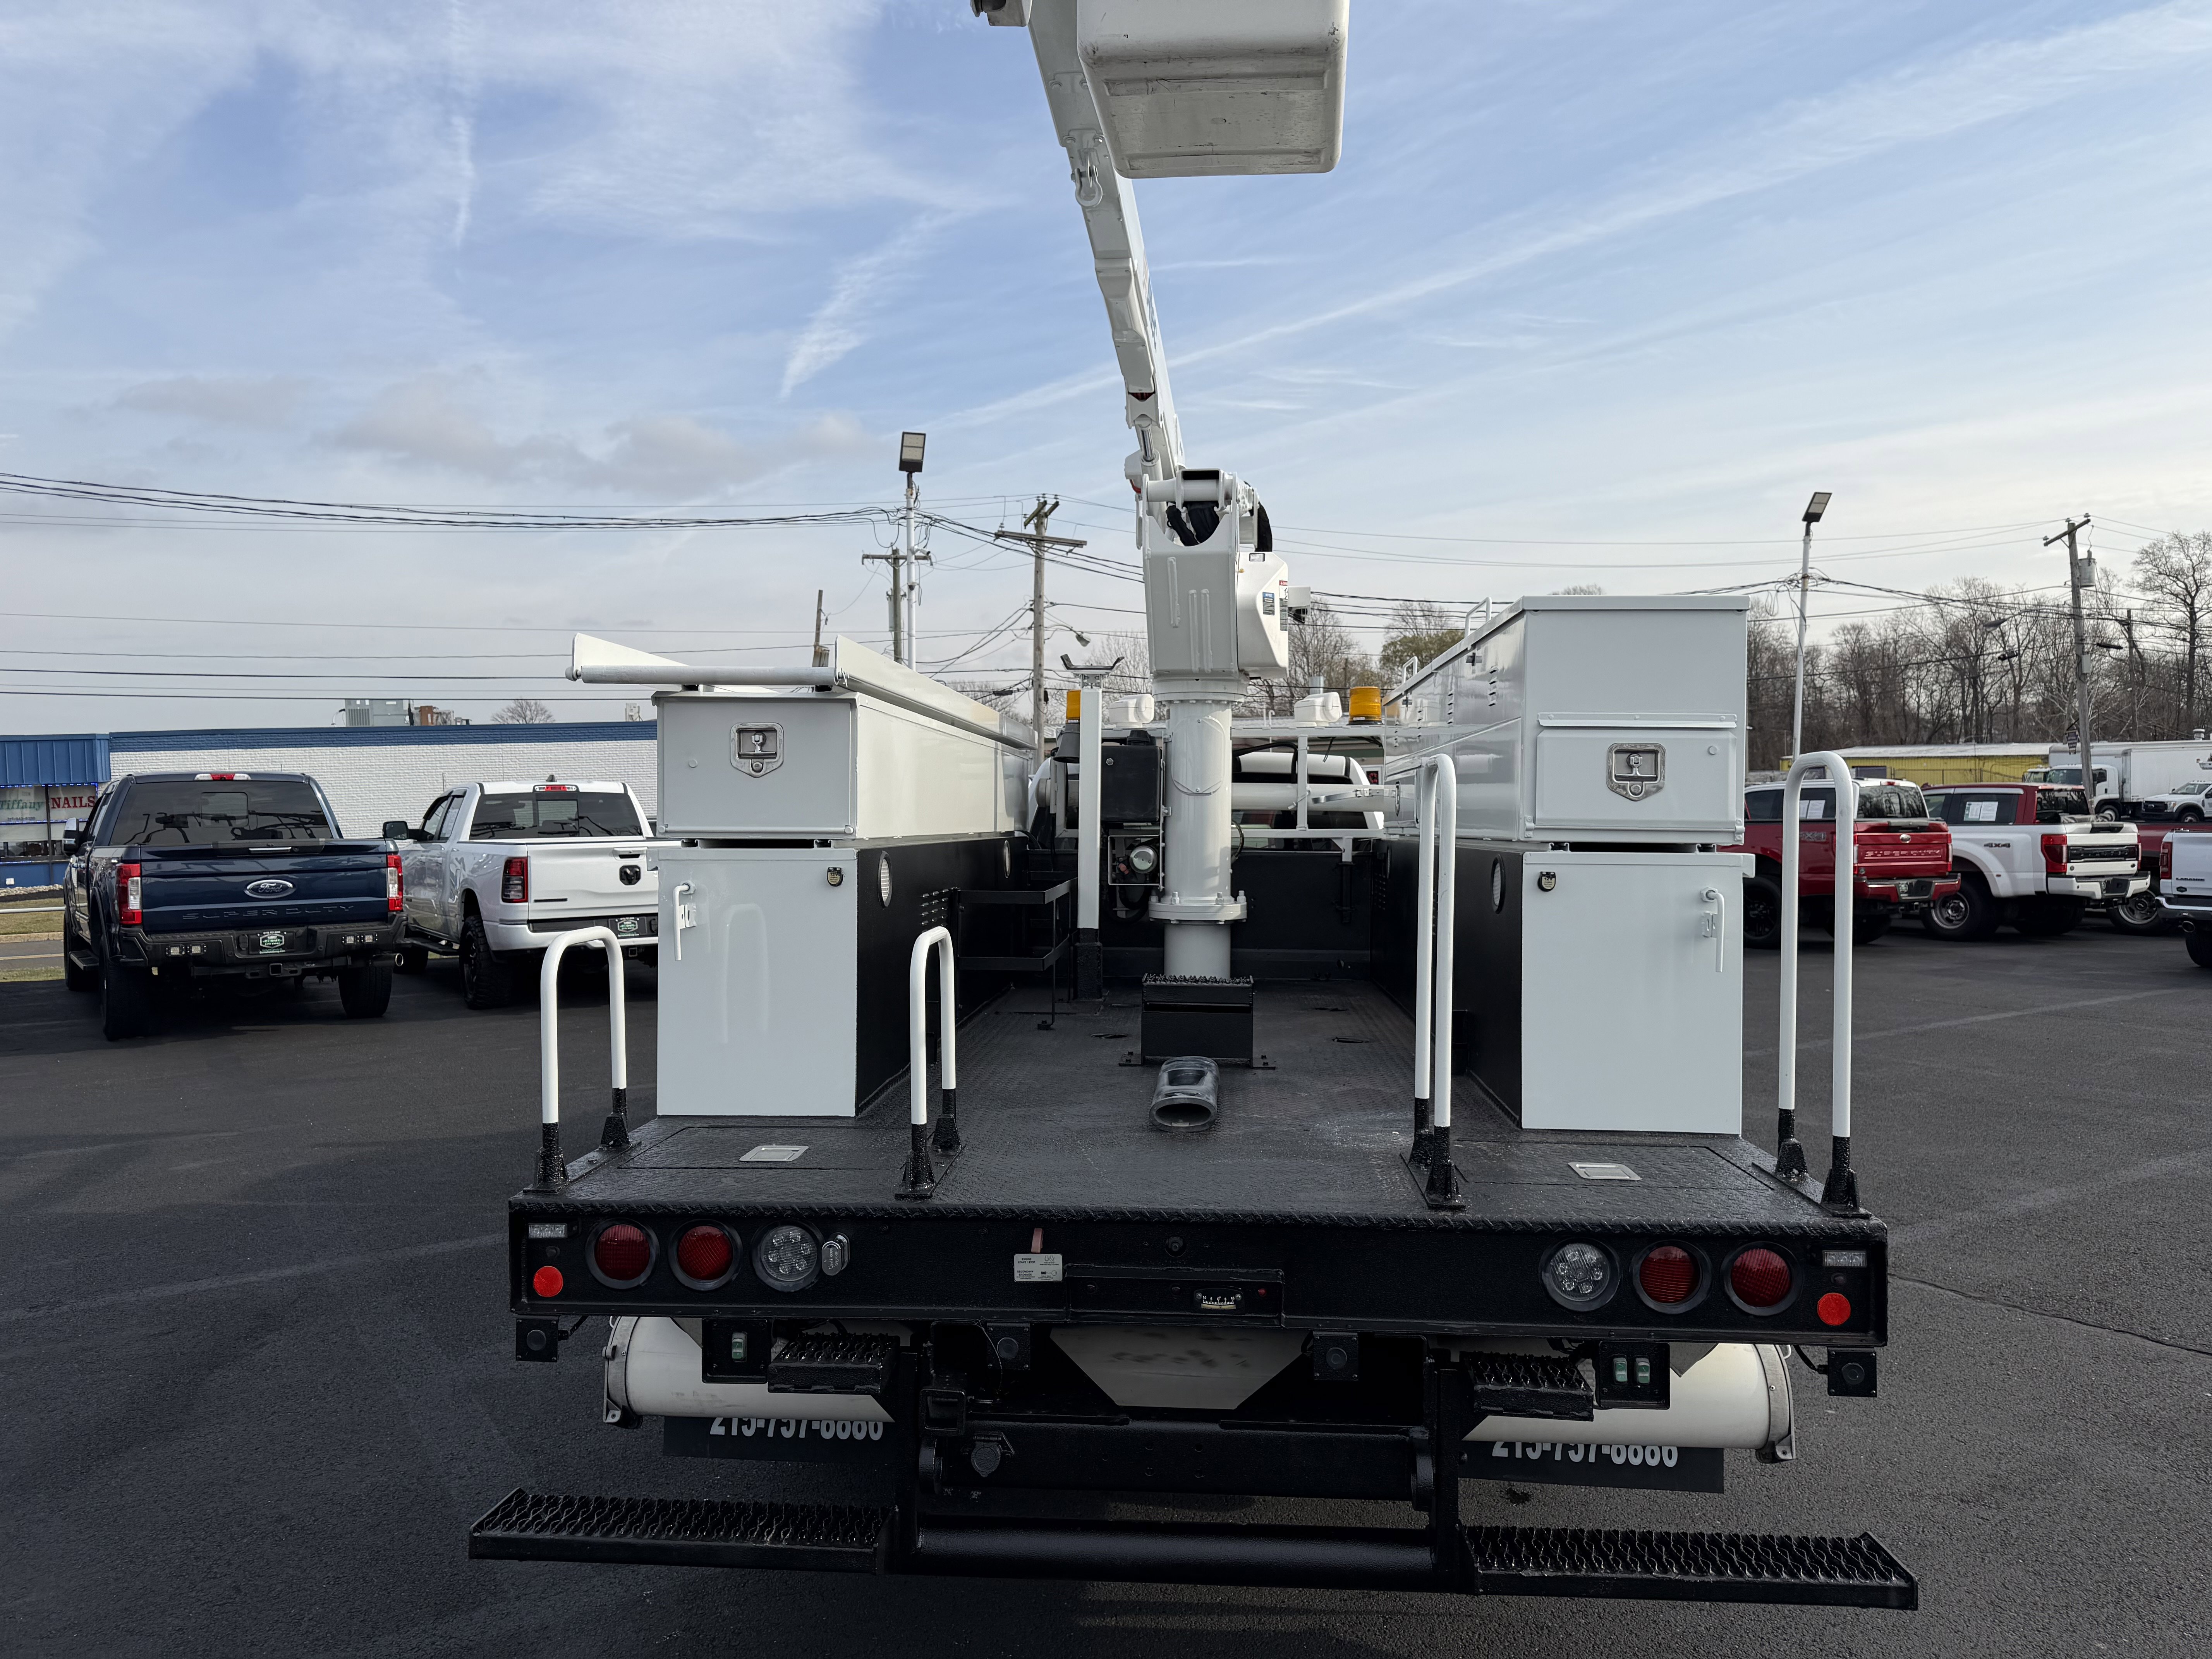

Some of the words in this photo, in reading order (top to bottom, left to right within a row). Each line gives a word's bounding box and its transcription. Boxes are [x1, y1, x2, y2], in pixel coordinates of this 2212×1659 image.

[0, 800, 45, 811] Tiffany
[51, 796, 95, 809] NAILS
[258, 883, 282, 893] Ford
[183, 909, 278, 919] SUPER
[286, 905, 354, 914] DUTY
